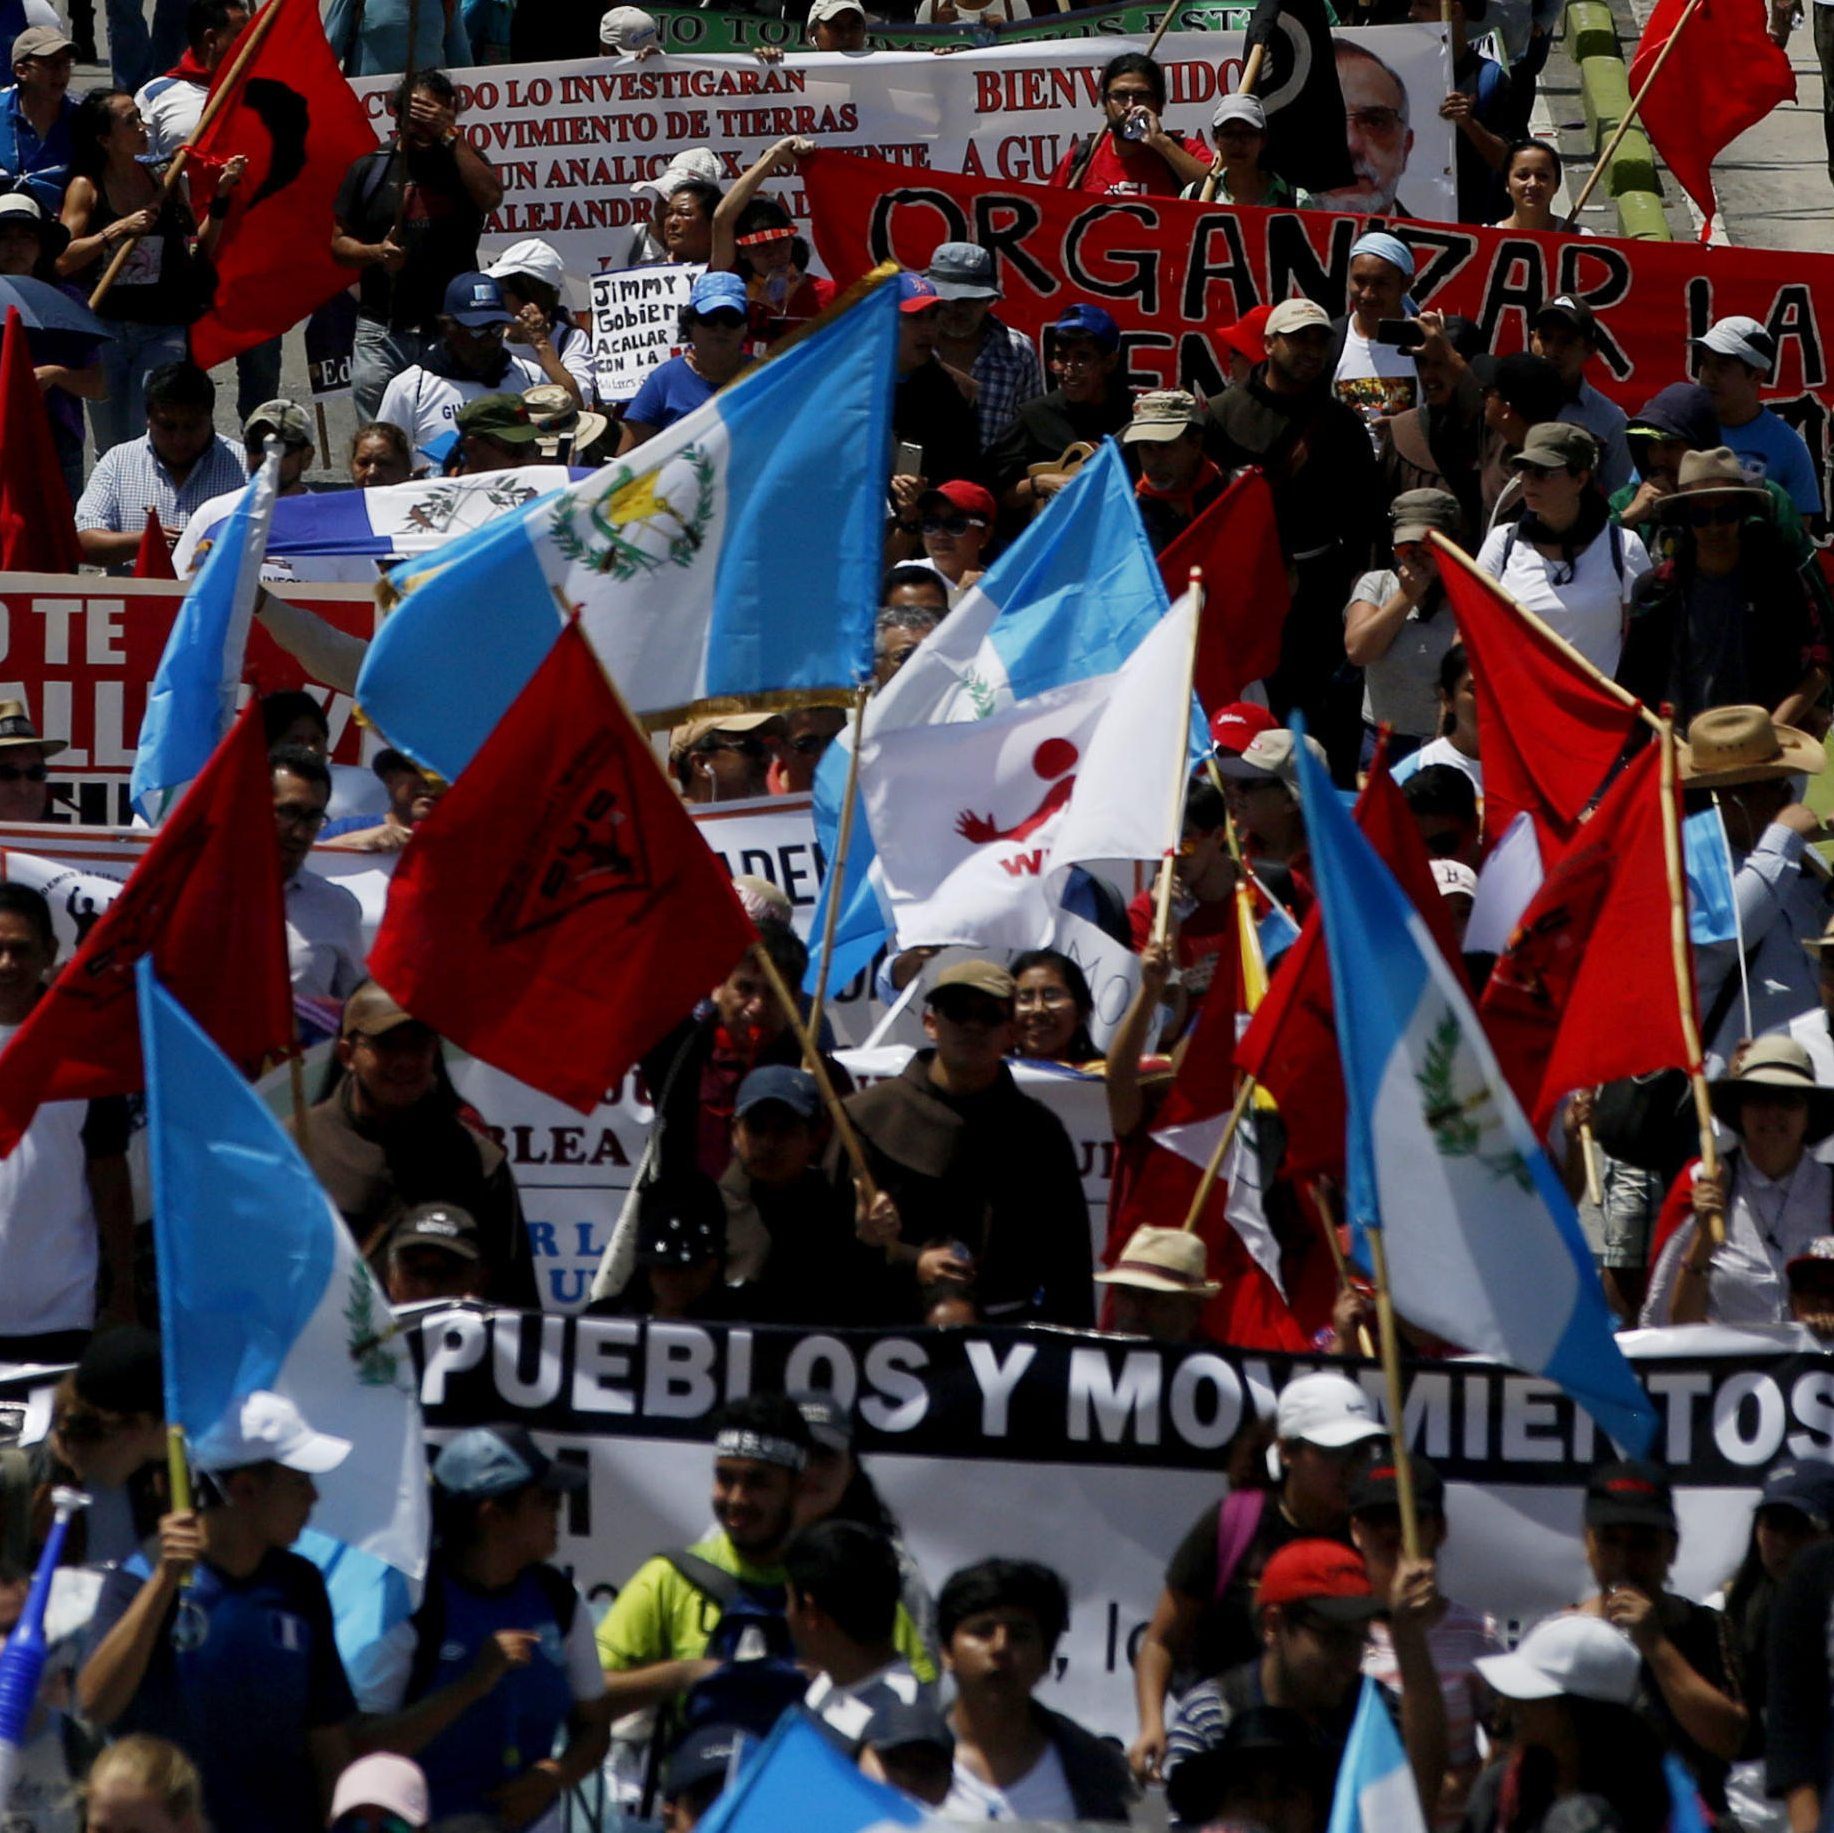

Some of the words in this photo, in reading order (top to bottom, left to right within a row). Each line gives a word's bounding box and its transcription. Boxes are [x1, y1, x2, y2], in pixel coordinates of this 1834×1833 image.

[507, 77, 555, 110] LO
[560, 68, 807, 105] INVESTIGARAN
[665, 109, 712, 140] DE
[718, 102, 859, 138] TIERRAS
[544, 155, 660, 190] ANALIC
[962, 137, 988, 177] A
[482, 195, 654, 234] ALEJANDR
[868, 188, 1633, 383] ORGANZAR
[30, 598, 128, 667] TE
[421, 1311, 931, 1435] PUEBLOS
[965, 1341, 1037, 1438] Y
